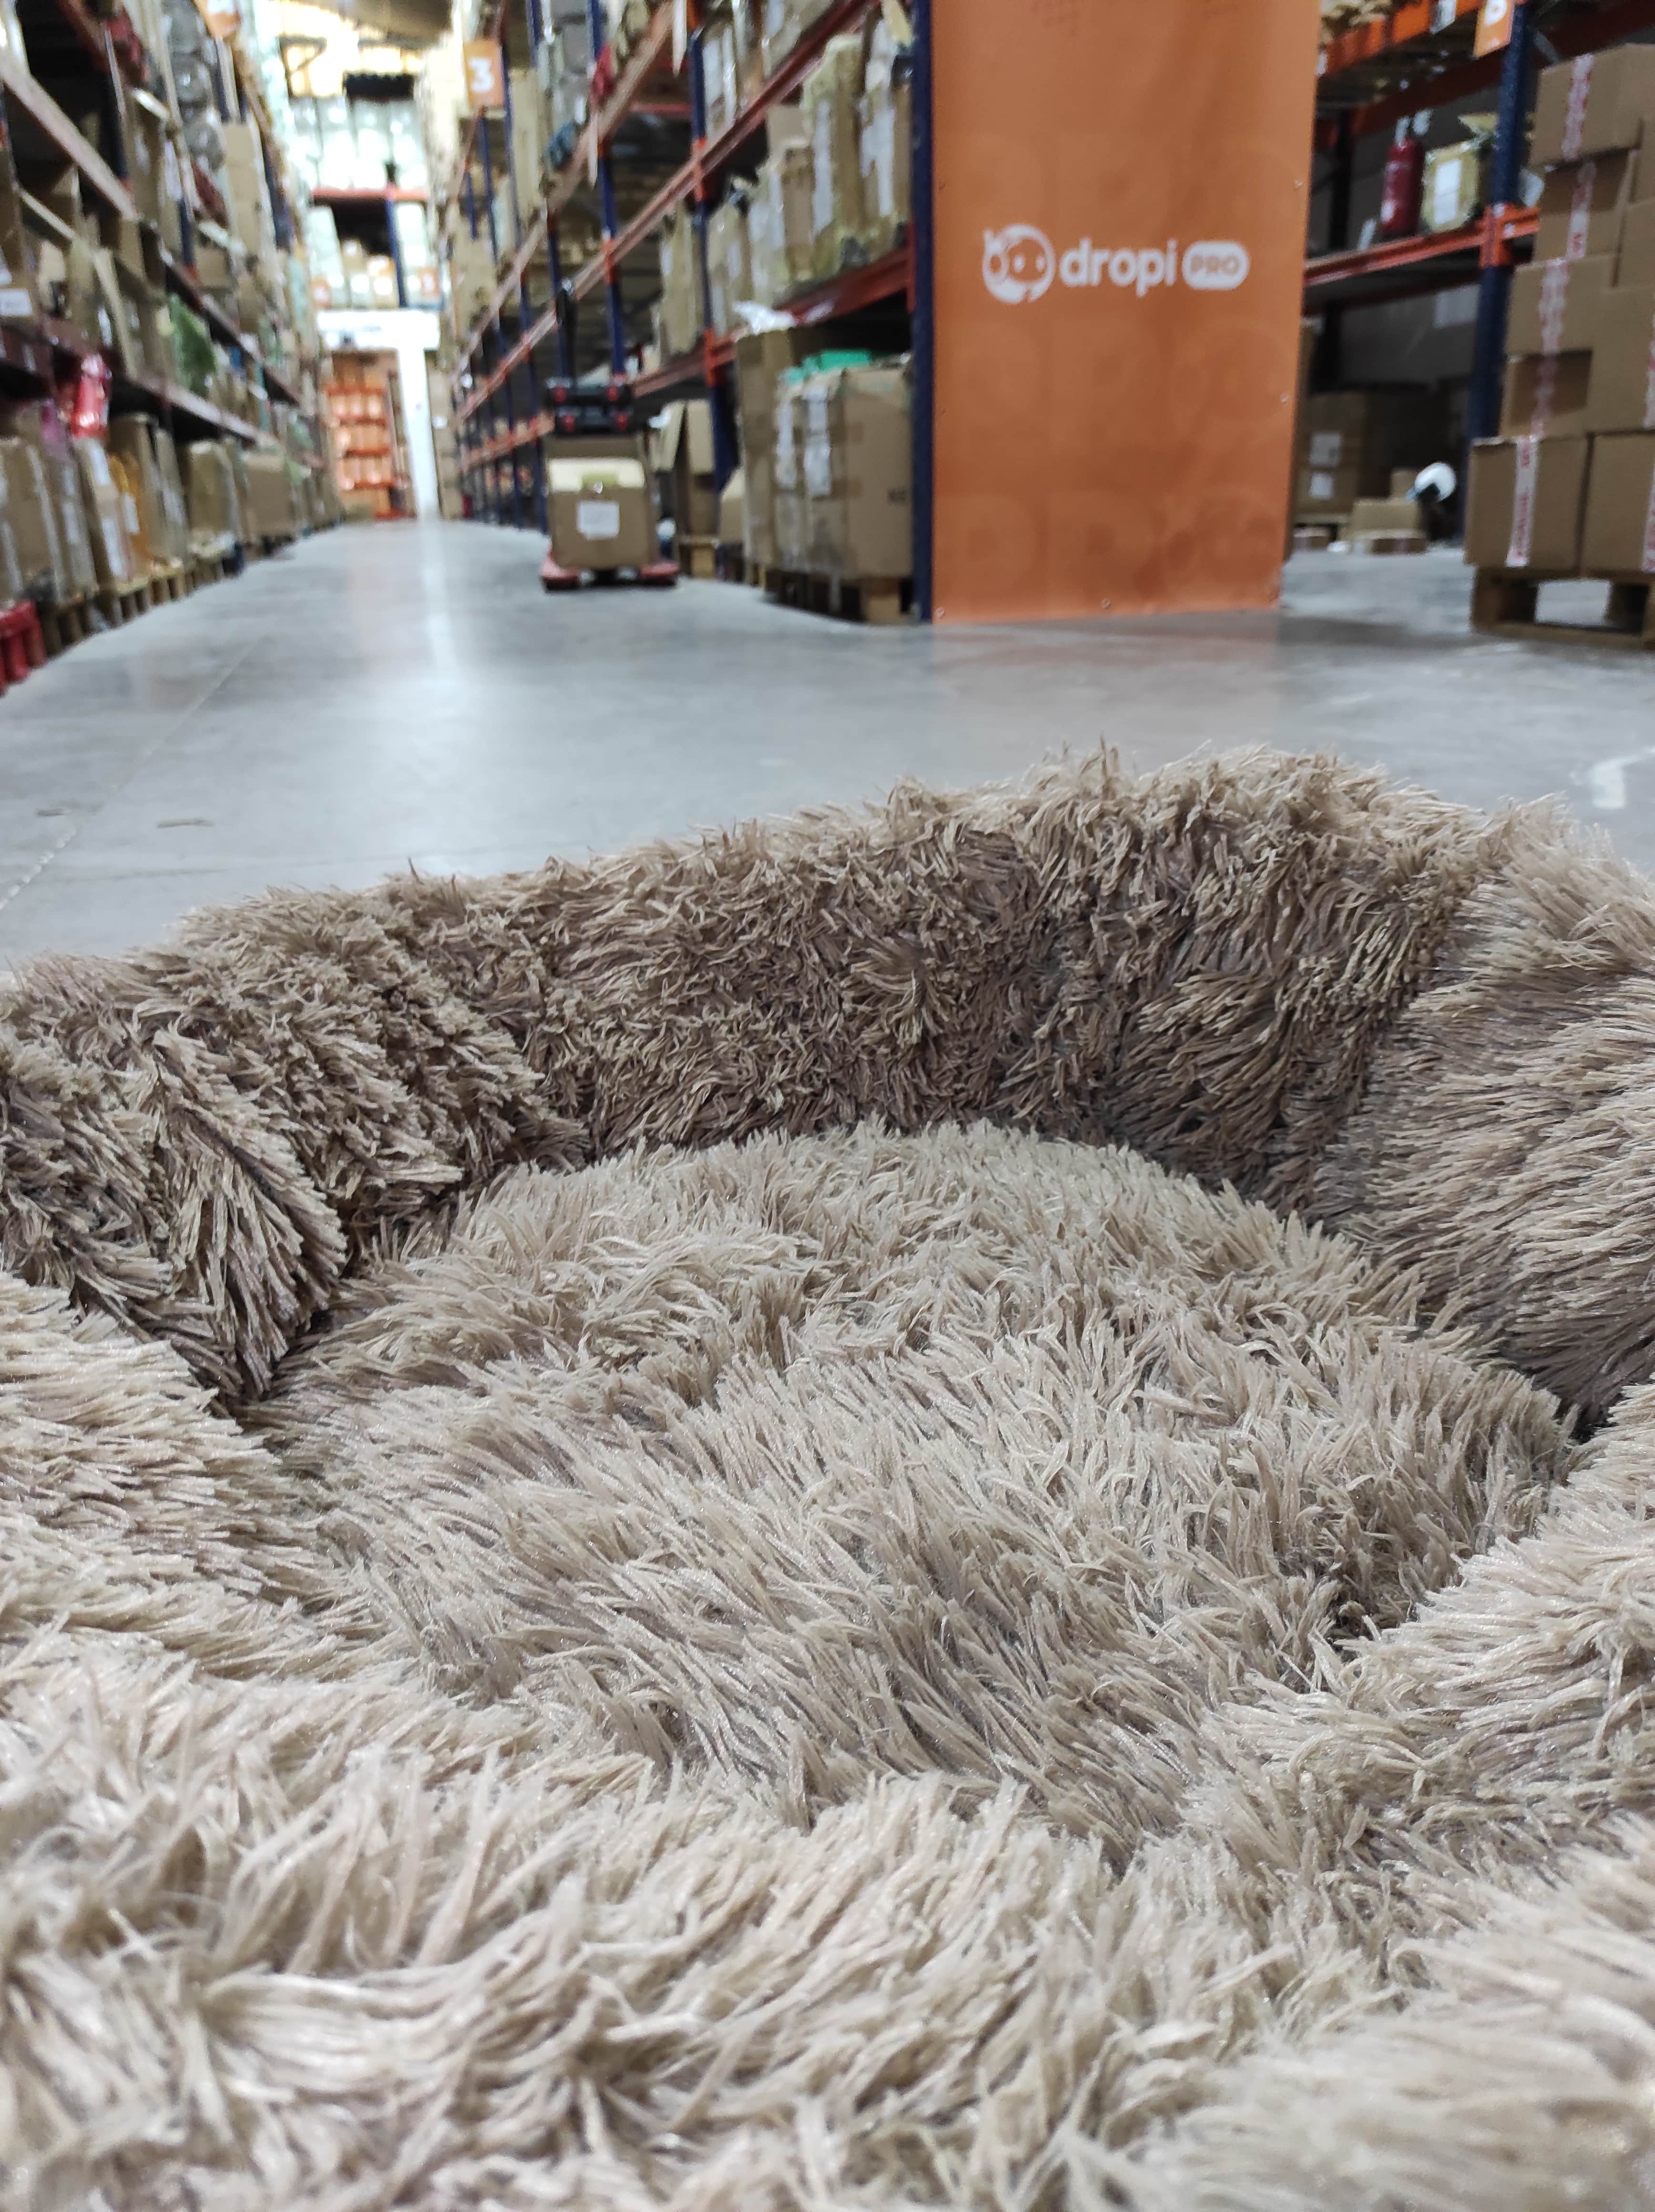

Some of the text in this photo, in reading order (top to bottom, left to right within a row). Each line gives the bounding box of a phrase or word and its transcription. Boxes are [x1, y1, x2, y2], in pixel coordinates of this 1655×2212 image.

[469, 58, 494, 92] 3
[1059, 236, 1240, 297] dropi PRO
